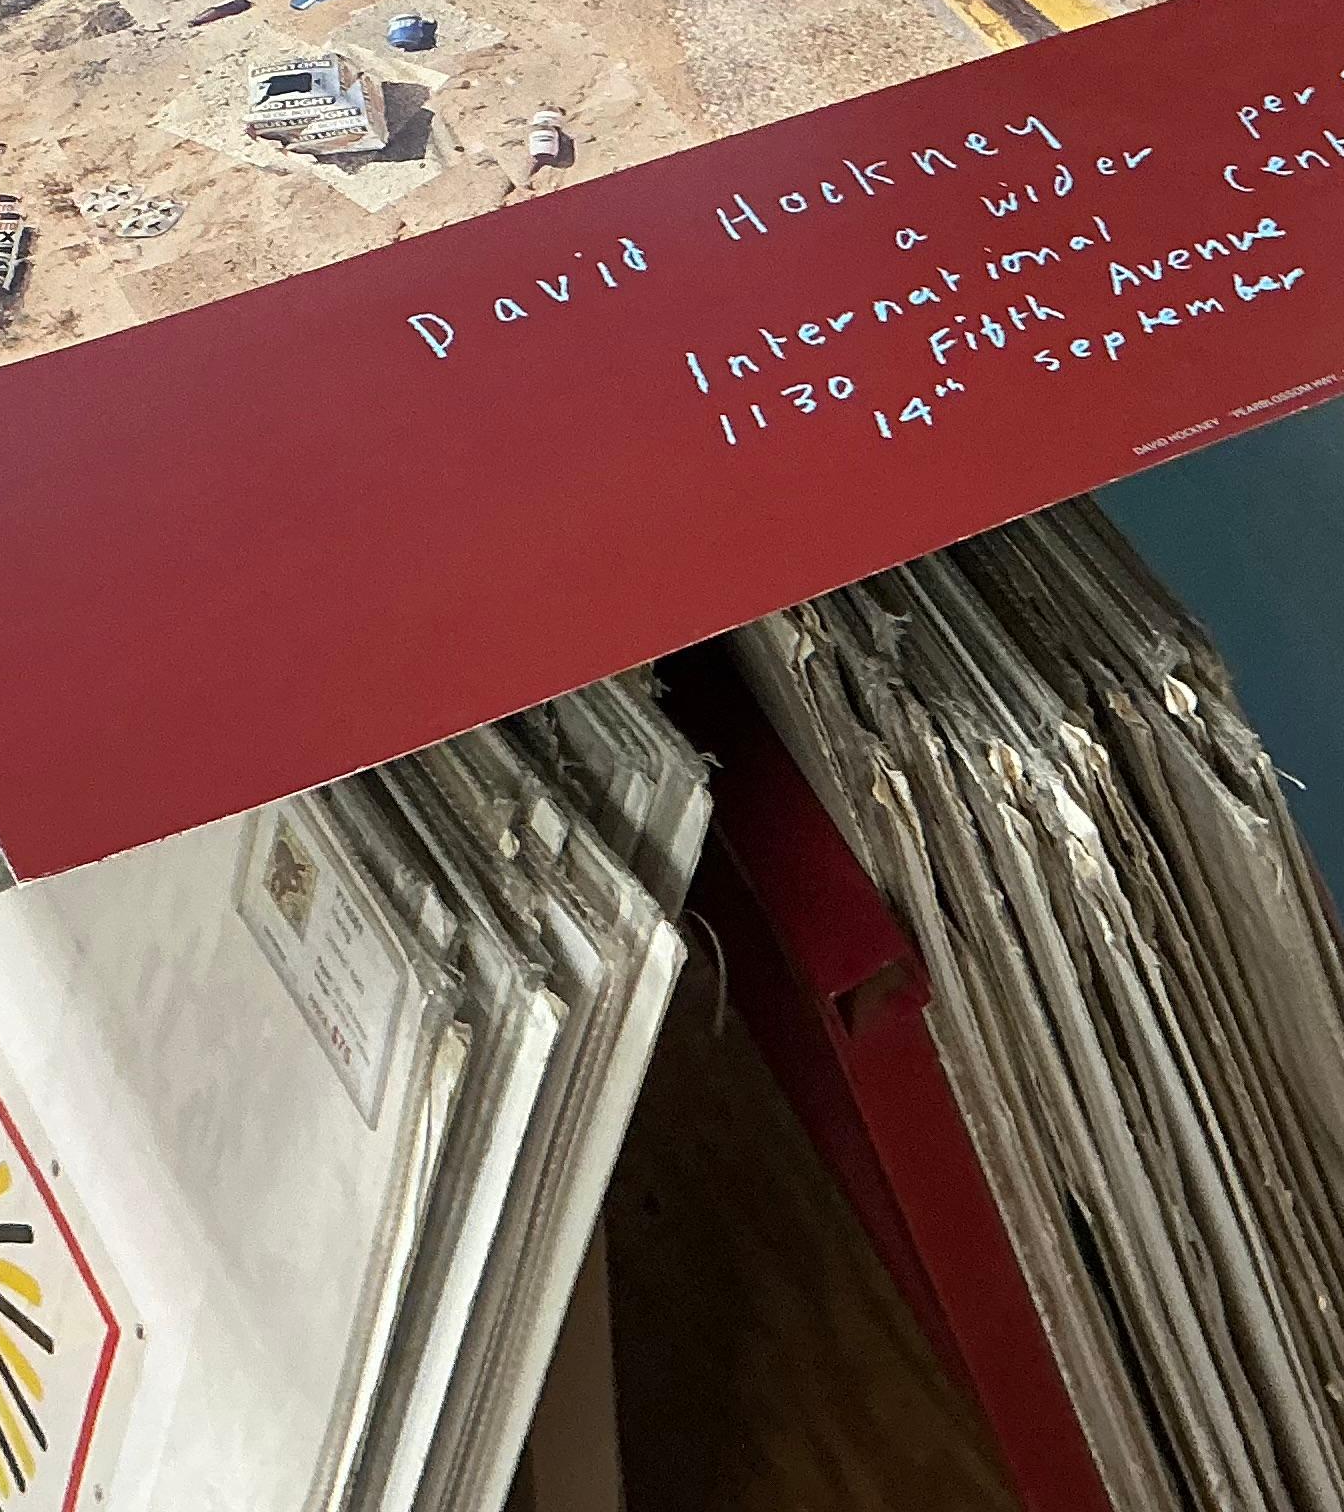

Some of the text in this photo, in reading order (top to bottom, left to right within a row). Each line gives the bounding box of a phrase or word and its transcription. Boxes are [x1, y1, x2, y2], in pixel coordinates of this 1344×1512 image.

[407, 237, 648, 359] David
[717, 115, 1063, 240] Hockney
[894, 227, 928, 250] a
[980, 147, 1153, 217] wider
[686, 215, 1112, 394] International
[720, 376, 855, 445] 1130
[928, 294, 1065, 365] Fifth
[1109, 217, 1287, 296] Avenue
